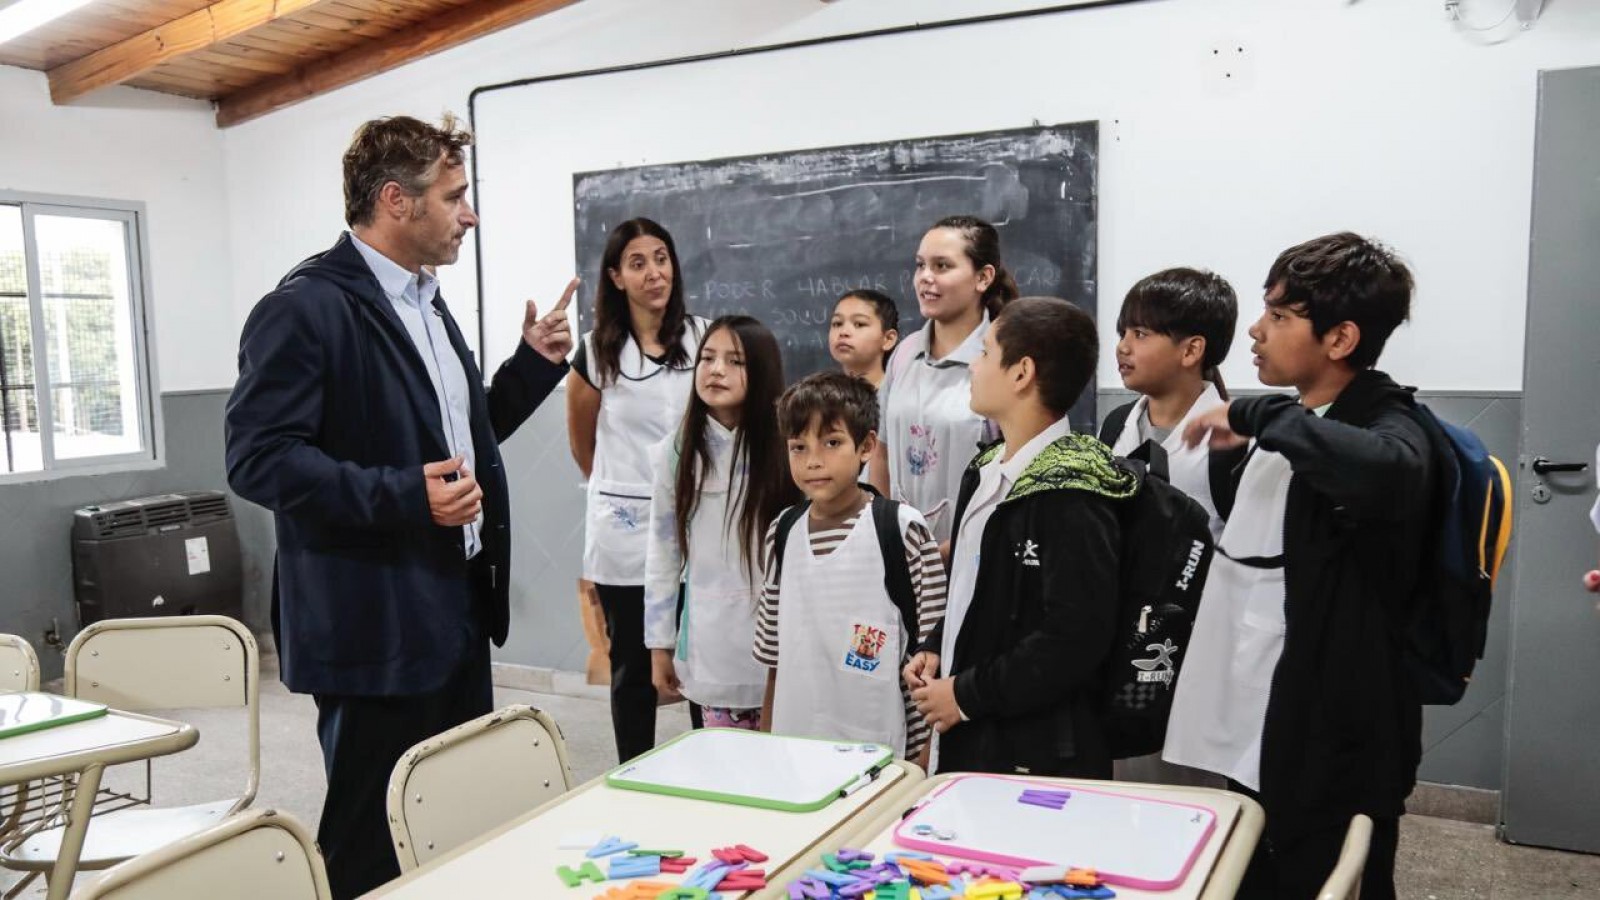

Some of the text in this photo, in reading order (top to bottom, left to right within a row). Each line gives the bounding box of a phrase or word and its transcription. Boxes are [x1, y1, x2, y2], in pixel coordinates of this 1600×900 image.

[704, 278, 776, 300] PODER
[1175, 539, 1205, 591] I-RUN
[845, 651, 881, 672] EASY
